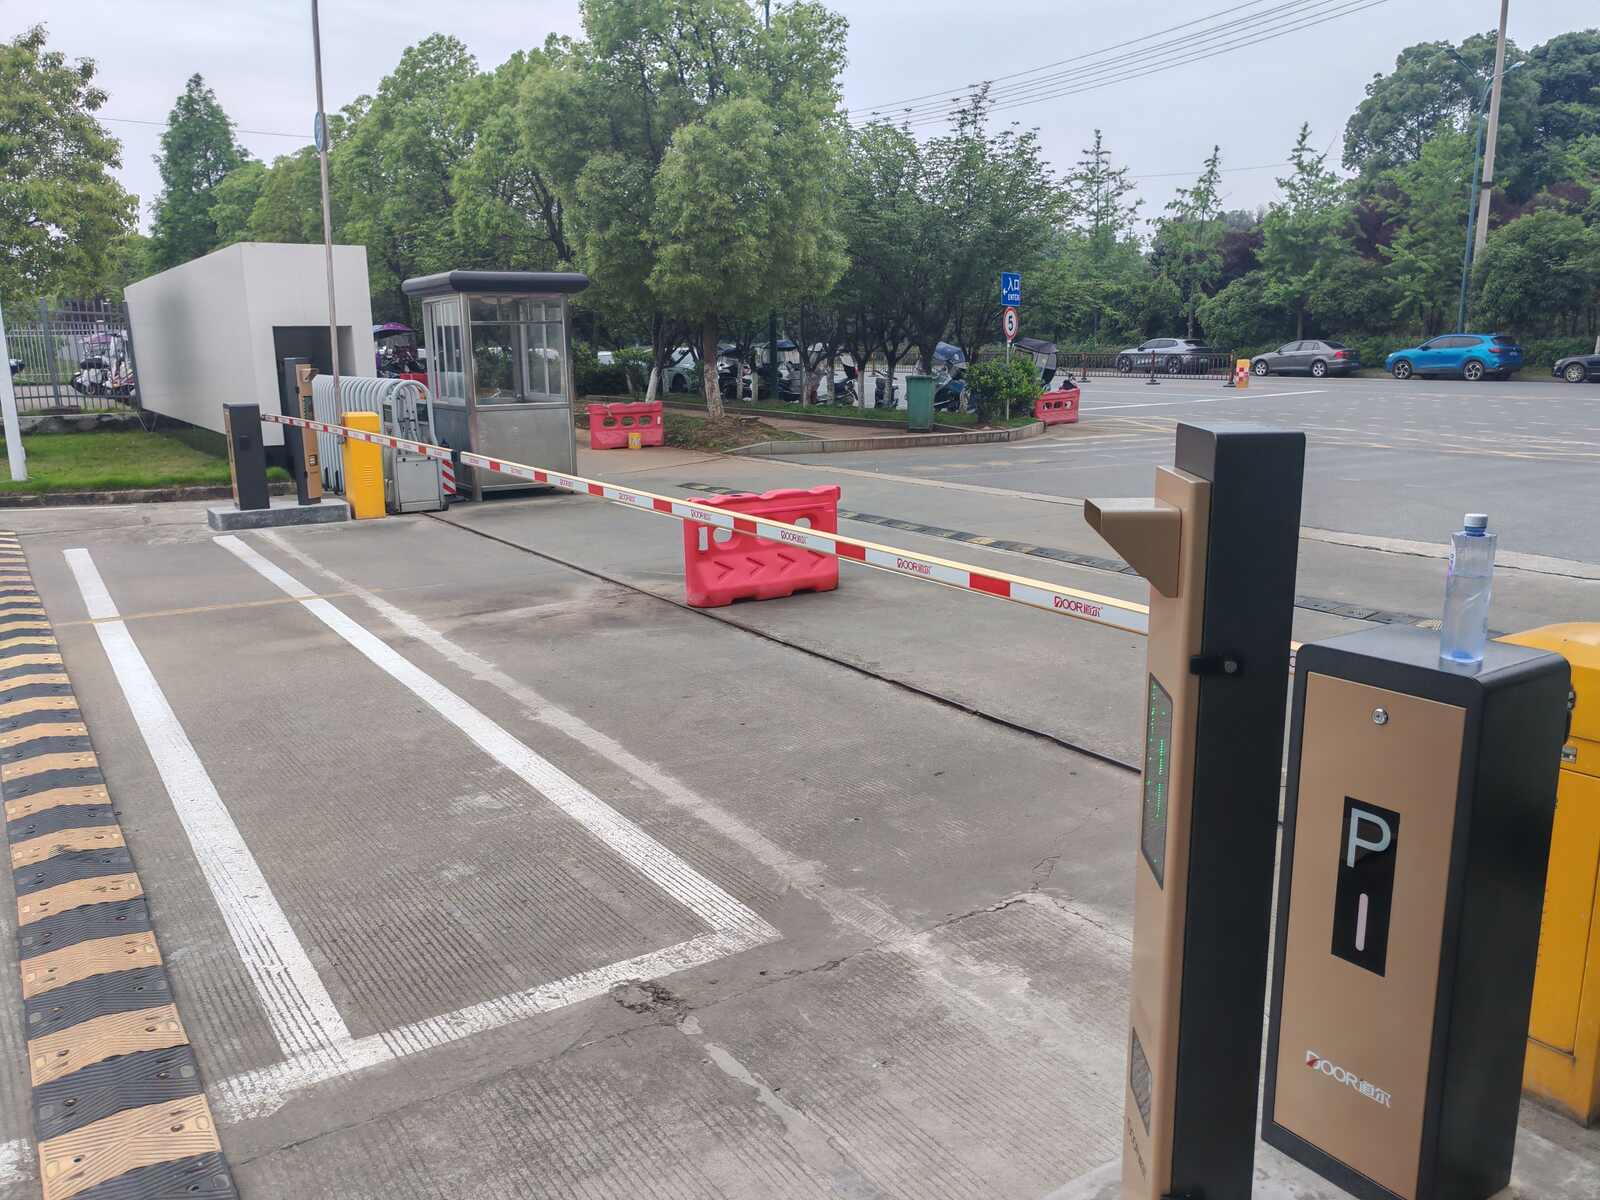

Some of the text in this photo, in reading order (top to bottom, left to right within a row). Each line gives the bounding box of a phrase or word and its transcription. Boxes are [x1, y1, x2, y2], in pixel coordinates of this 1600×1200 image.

[1008, 278, 1020, 291] 入口
[1008, 315, 1014, 331] 5
[1346, 807, 1392, 868] P
